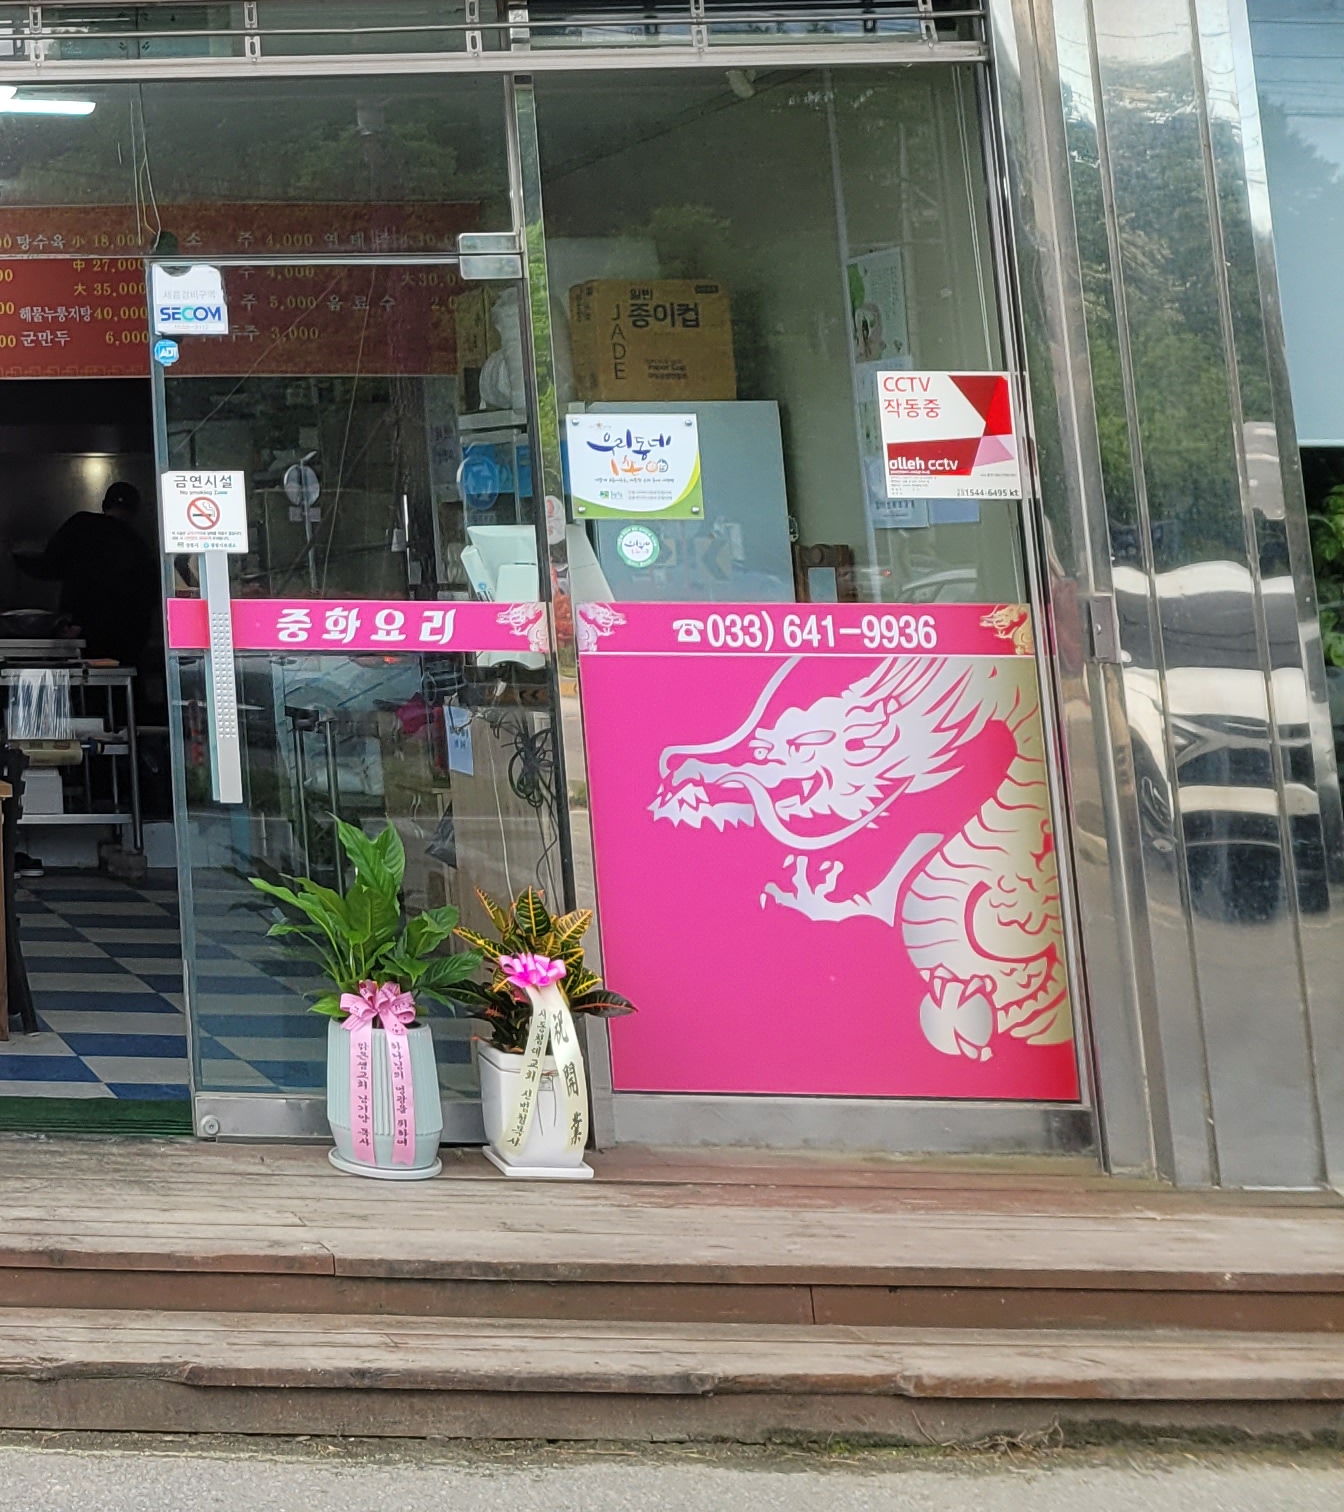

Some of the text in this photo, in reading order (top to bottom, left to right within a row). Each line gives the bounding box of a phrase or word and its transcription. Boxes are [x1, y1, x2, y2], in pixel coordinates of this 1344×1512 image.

[16, 234, 66, 250] 탕수육
[159, 305, 222, 322] SECOM
[627, 302, 701, 329] 종이컵
[21, 330, 72, 348] 군만두
[610, 302, 628, 381] JADE
[882, 375, 932, 393] CCTV
[883, 397, 942, 419] 작동중
[927, 456, 959, 471] cctv
[173, 474, 233, 489] 금연시설
[276, 606, 457, 645] 중화요리
